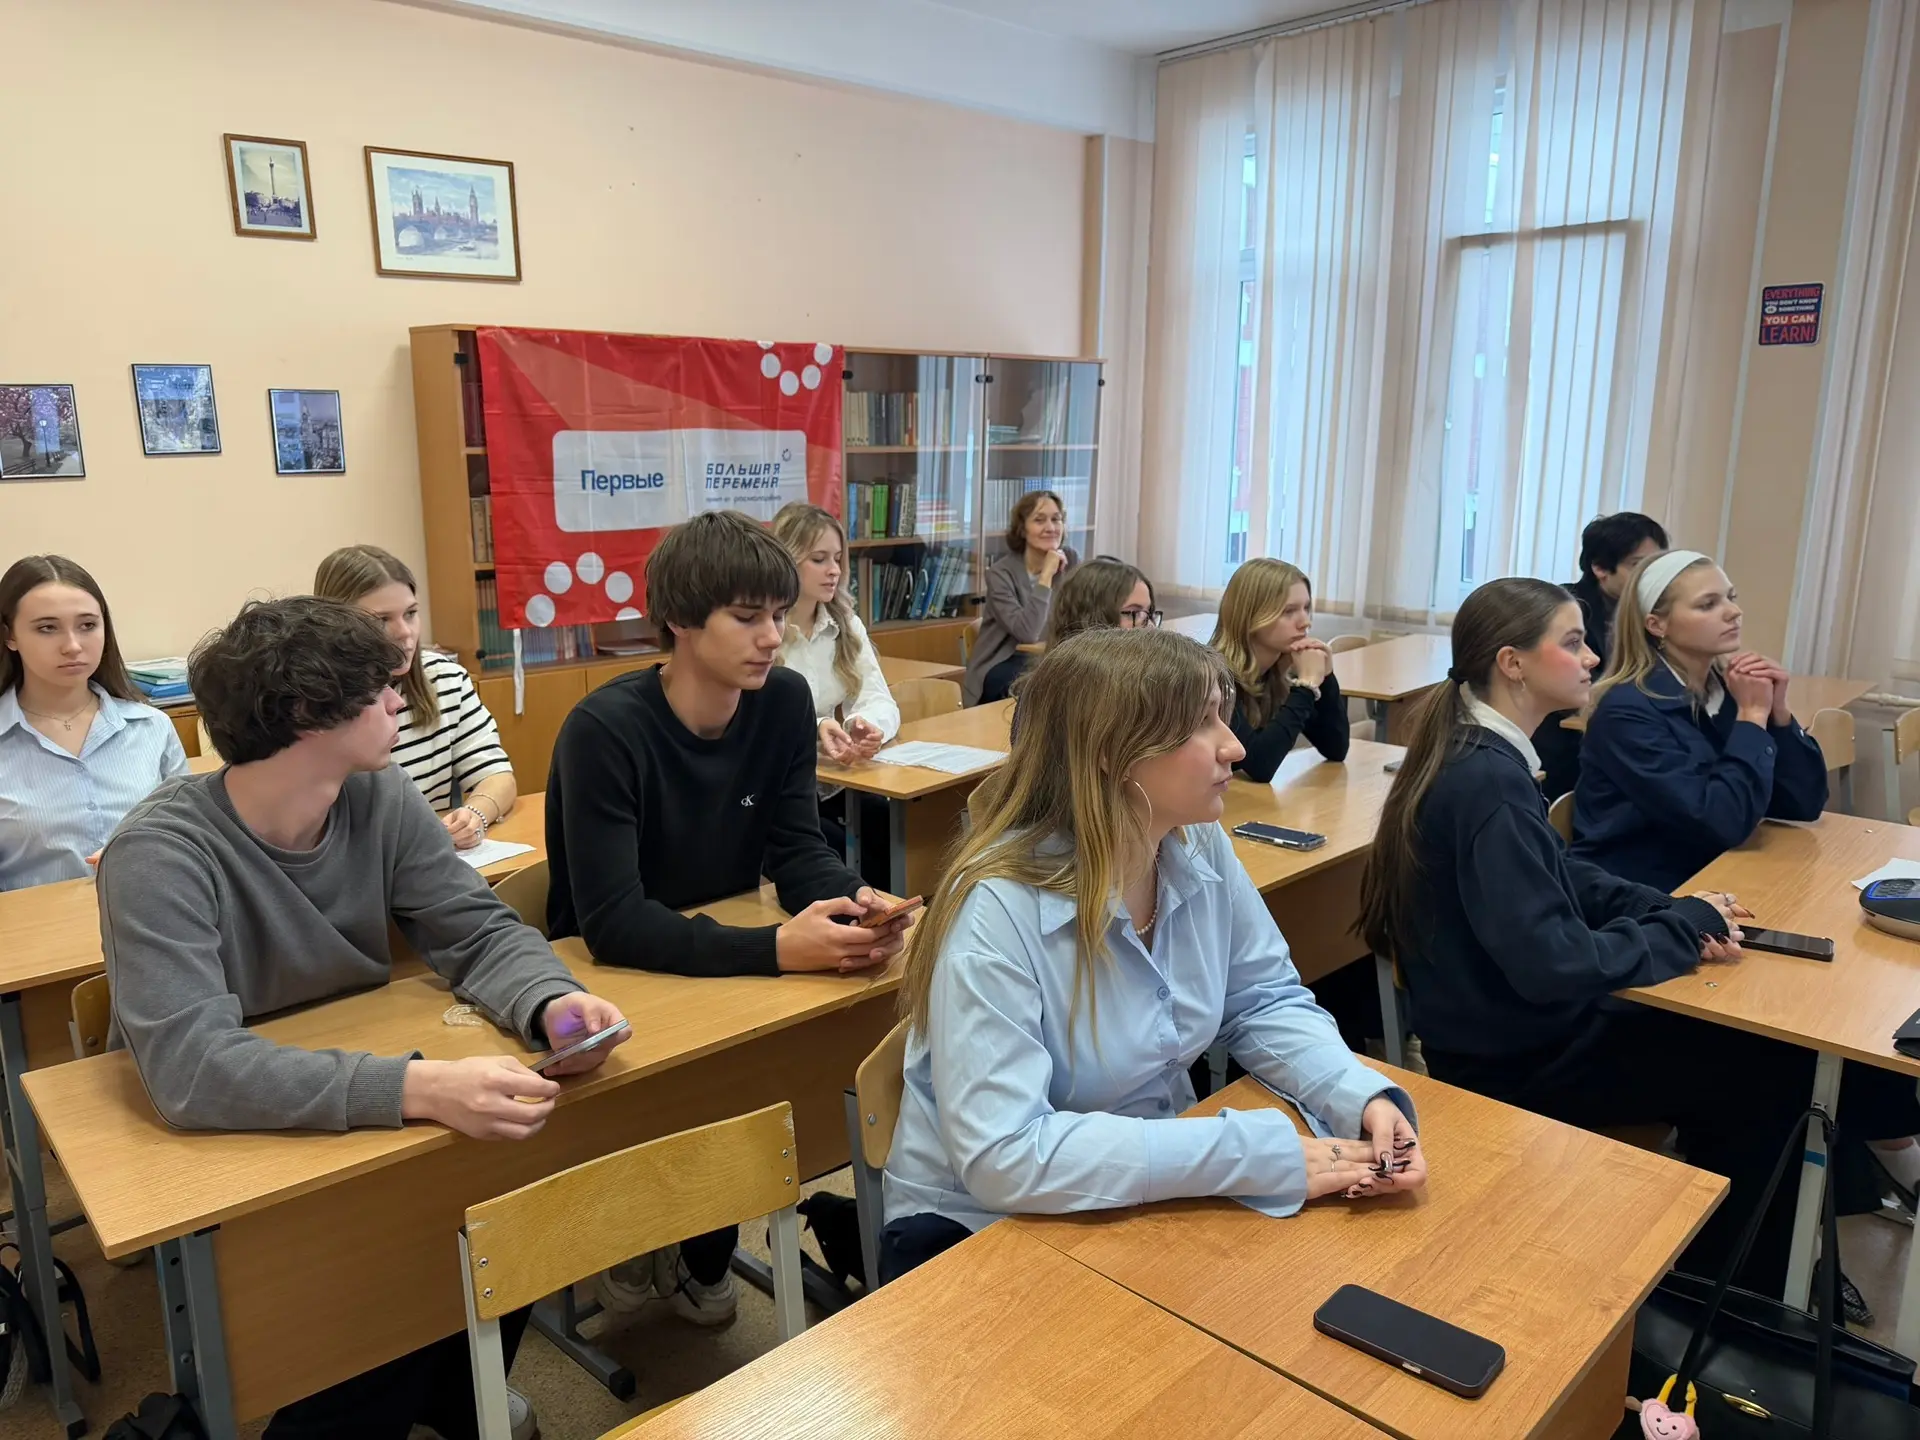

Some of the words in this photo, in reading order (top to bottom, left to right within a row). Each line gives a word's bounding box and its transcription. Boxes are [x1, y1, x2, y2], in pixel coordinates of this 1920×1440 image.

[1765, 288, 1820, 300] EVERYTHING
[1765, 316, 1788, 325] YOU
[1791, 314, 1815, 324] CAN
[1761, 325, 1816, 343] LEARN!
[706, 463, 781, 476] БОЛЬШАЯ
[581, 469, 664, 497] Первые
[705, 476, 780, 489] ПЕРЕМЕНА
